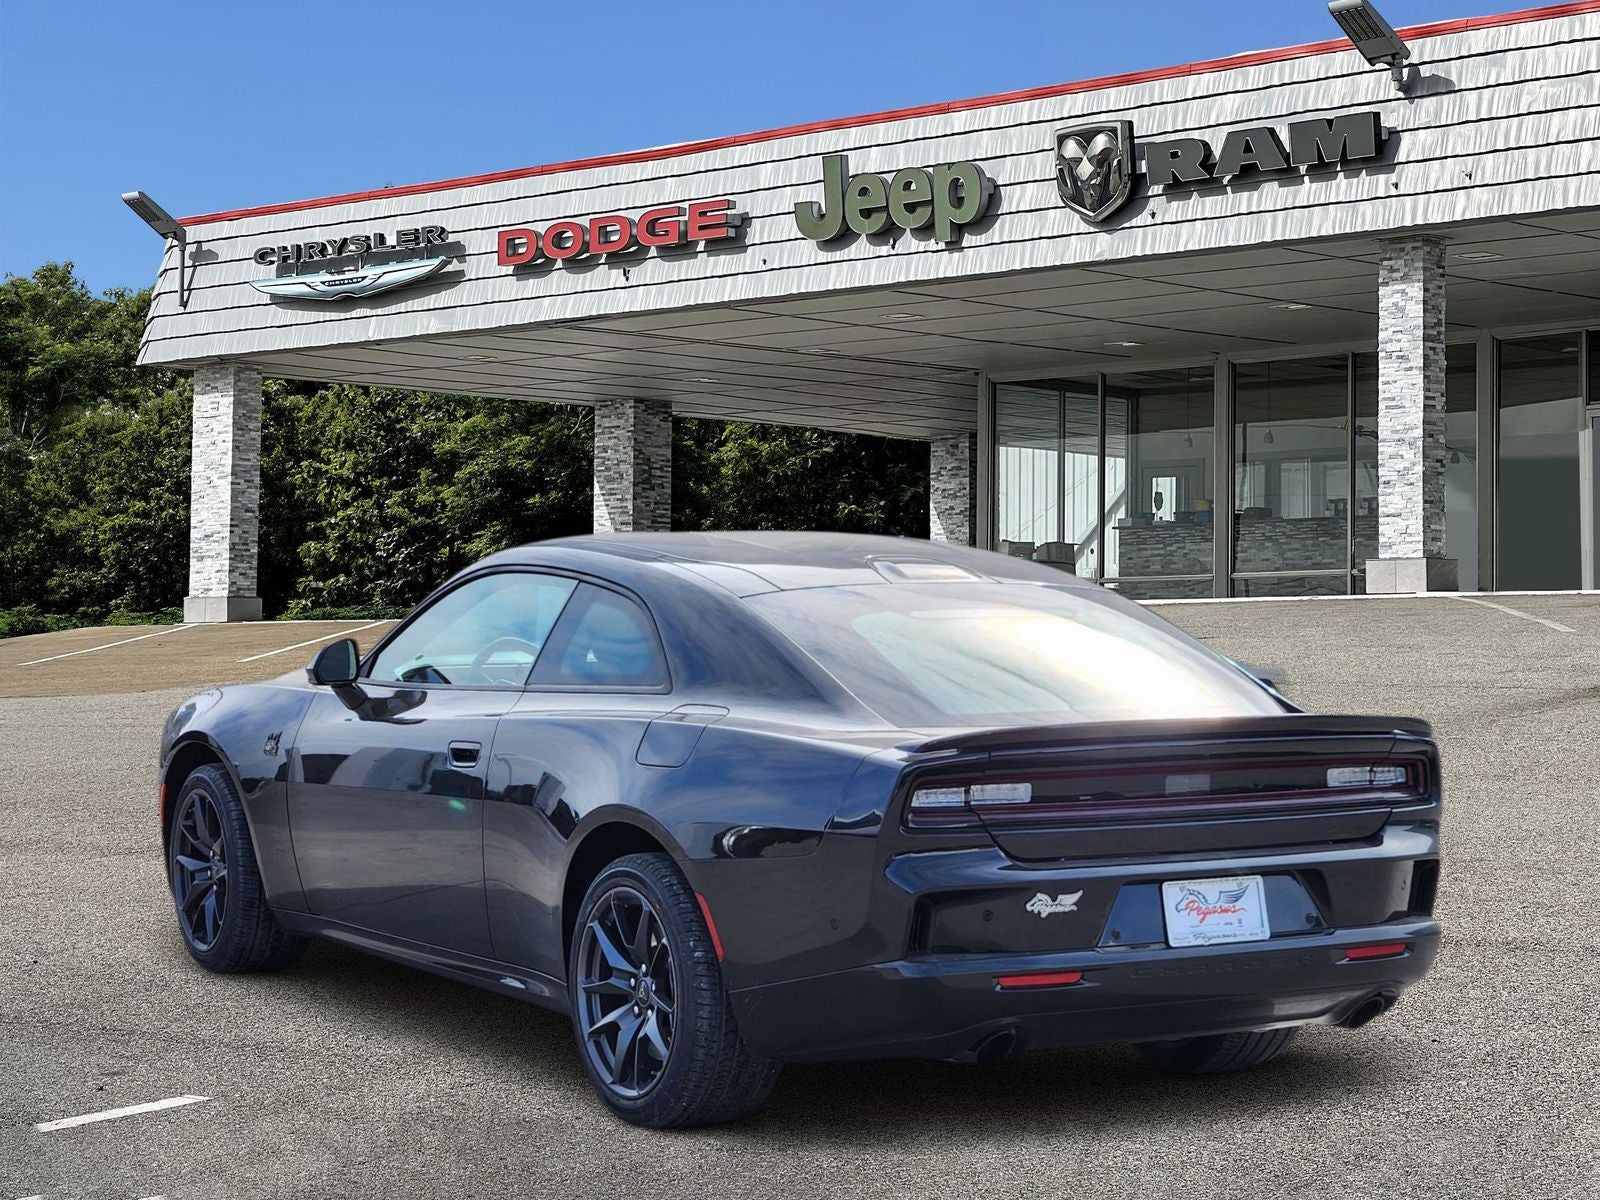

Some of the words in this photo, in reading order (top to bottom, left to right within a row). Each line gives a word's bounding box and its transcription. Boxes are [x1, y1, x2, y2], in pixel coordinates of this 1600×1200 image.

[1145, 112, 1380, 187] RAM
[794, 154, 988, 243] Jeep
[253, 225, 449, 266] CHRYSLER
[498, 199, 736, 266] DODGE
[1185, 899, 1247, 923] Pegasus
